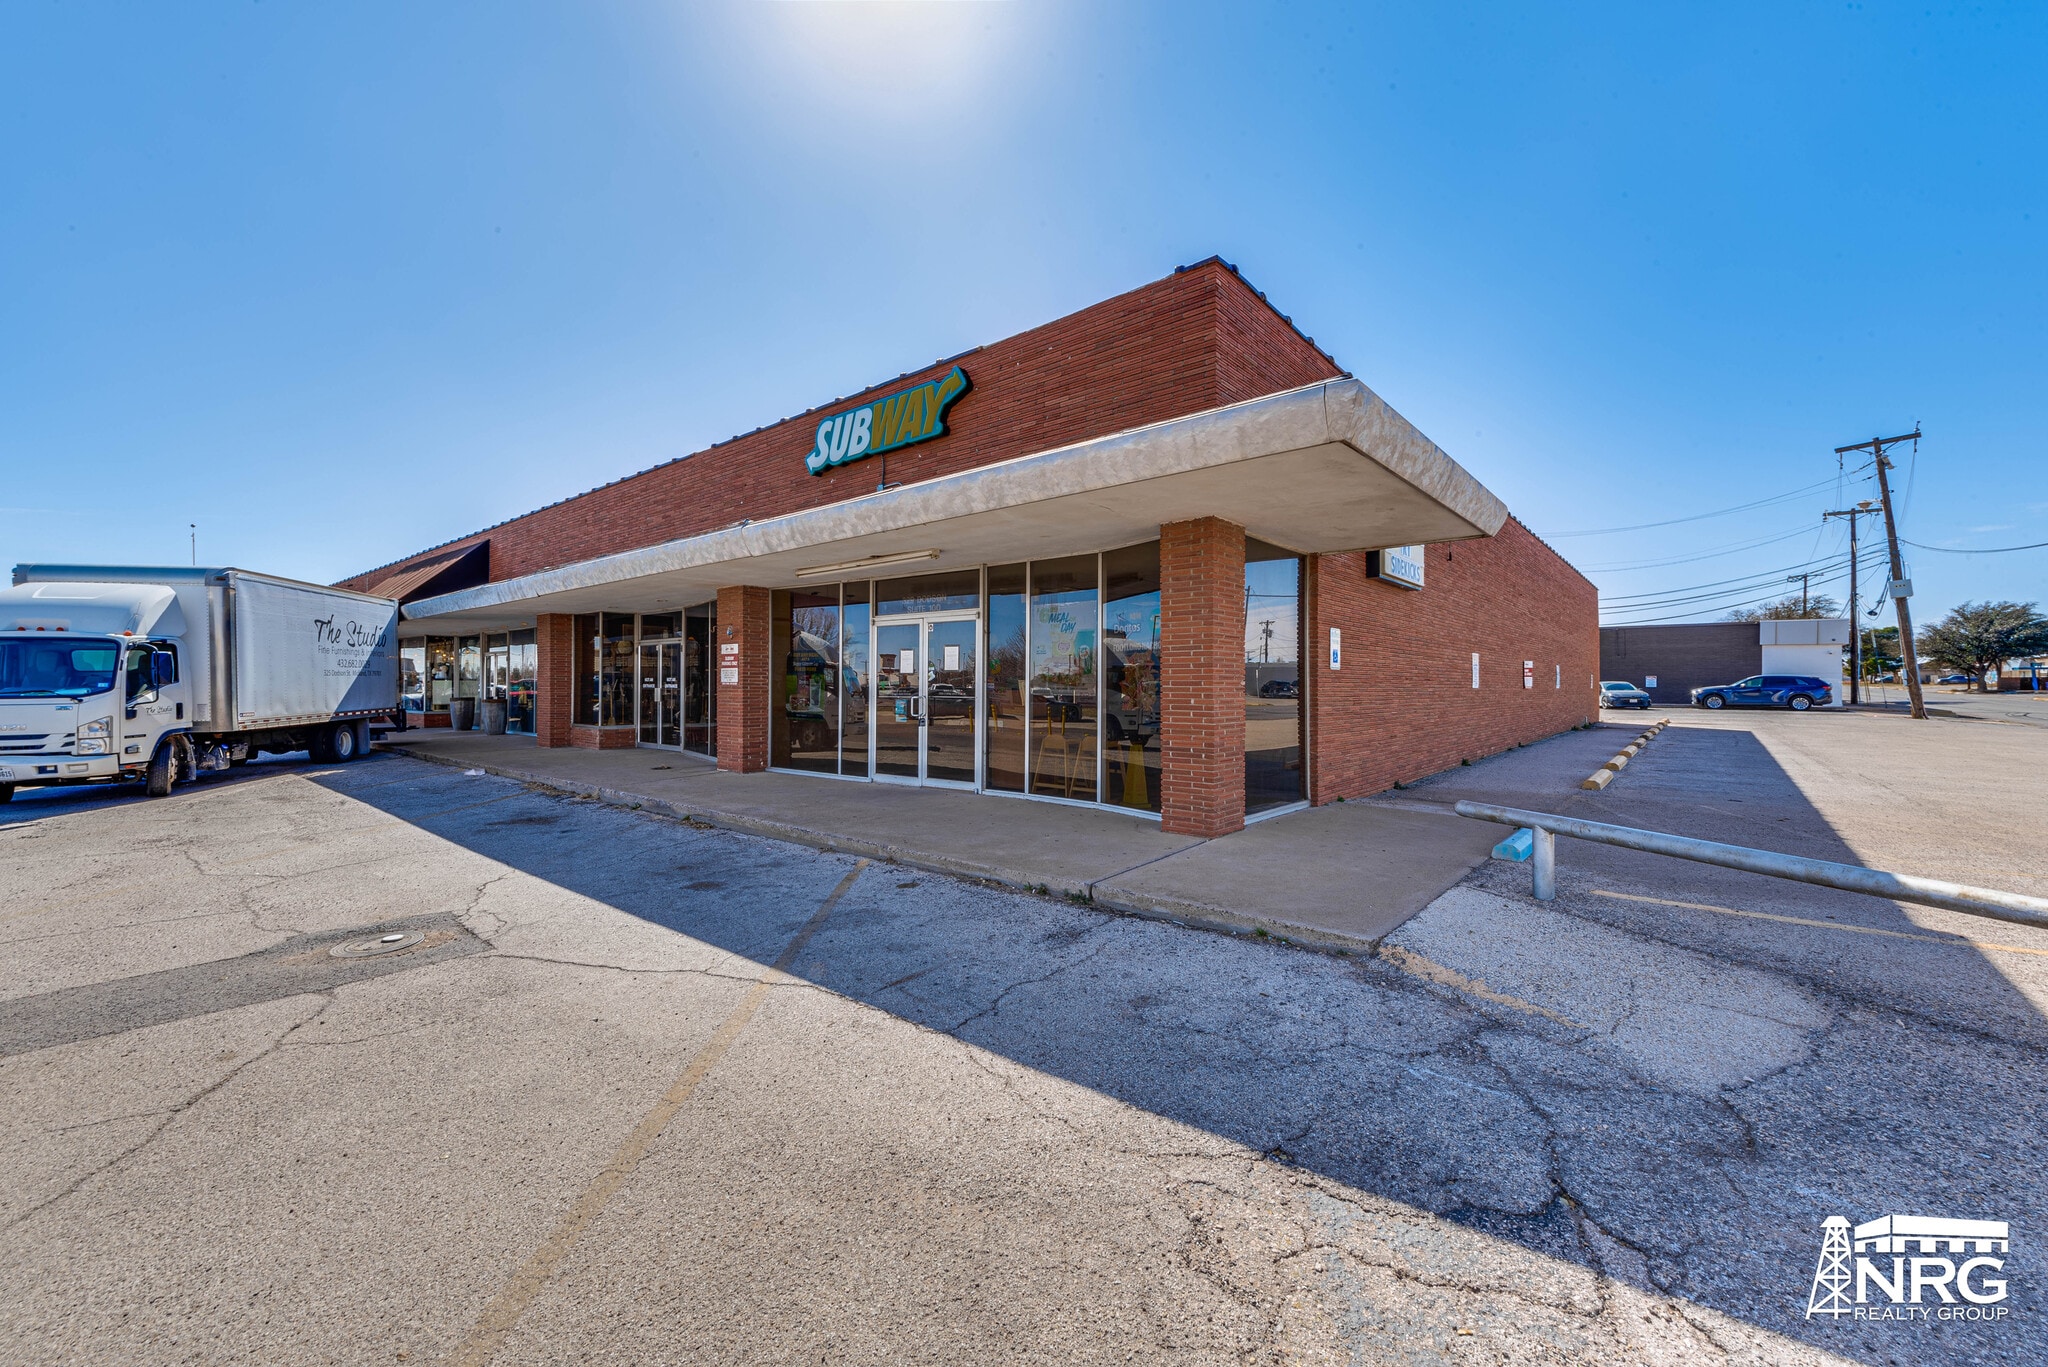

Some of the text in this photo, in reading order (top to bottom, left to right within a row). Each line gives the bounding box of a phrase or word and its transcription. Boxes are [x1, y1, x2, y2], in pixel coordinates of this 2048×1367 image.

[807, 371, 963, 470] SUBWAY
[1391, 555, 1420, 582] SIDEKICKS
[916, 594, 946, 602] DODSON
[1048, 611, 1070, 624] MEAL
[314, 614, 387, 648] The Studio
[1060, 621, 1076, 634] DAY
[1113, 623, 1141, 634] Doritos
[317, 645, 330, 655] Fine
